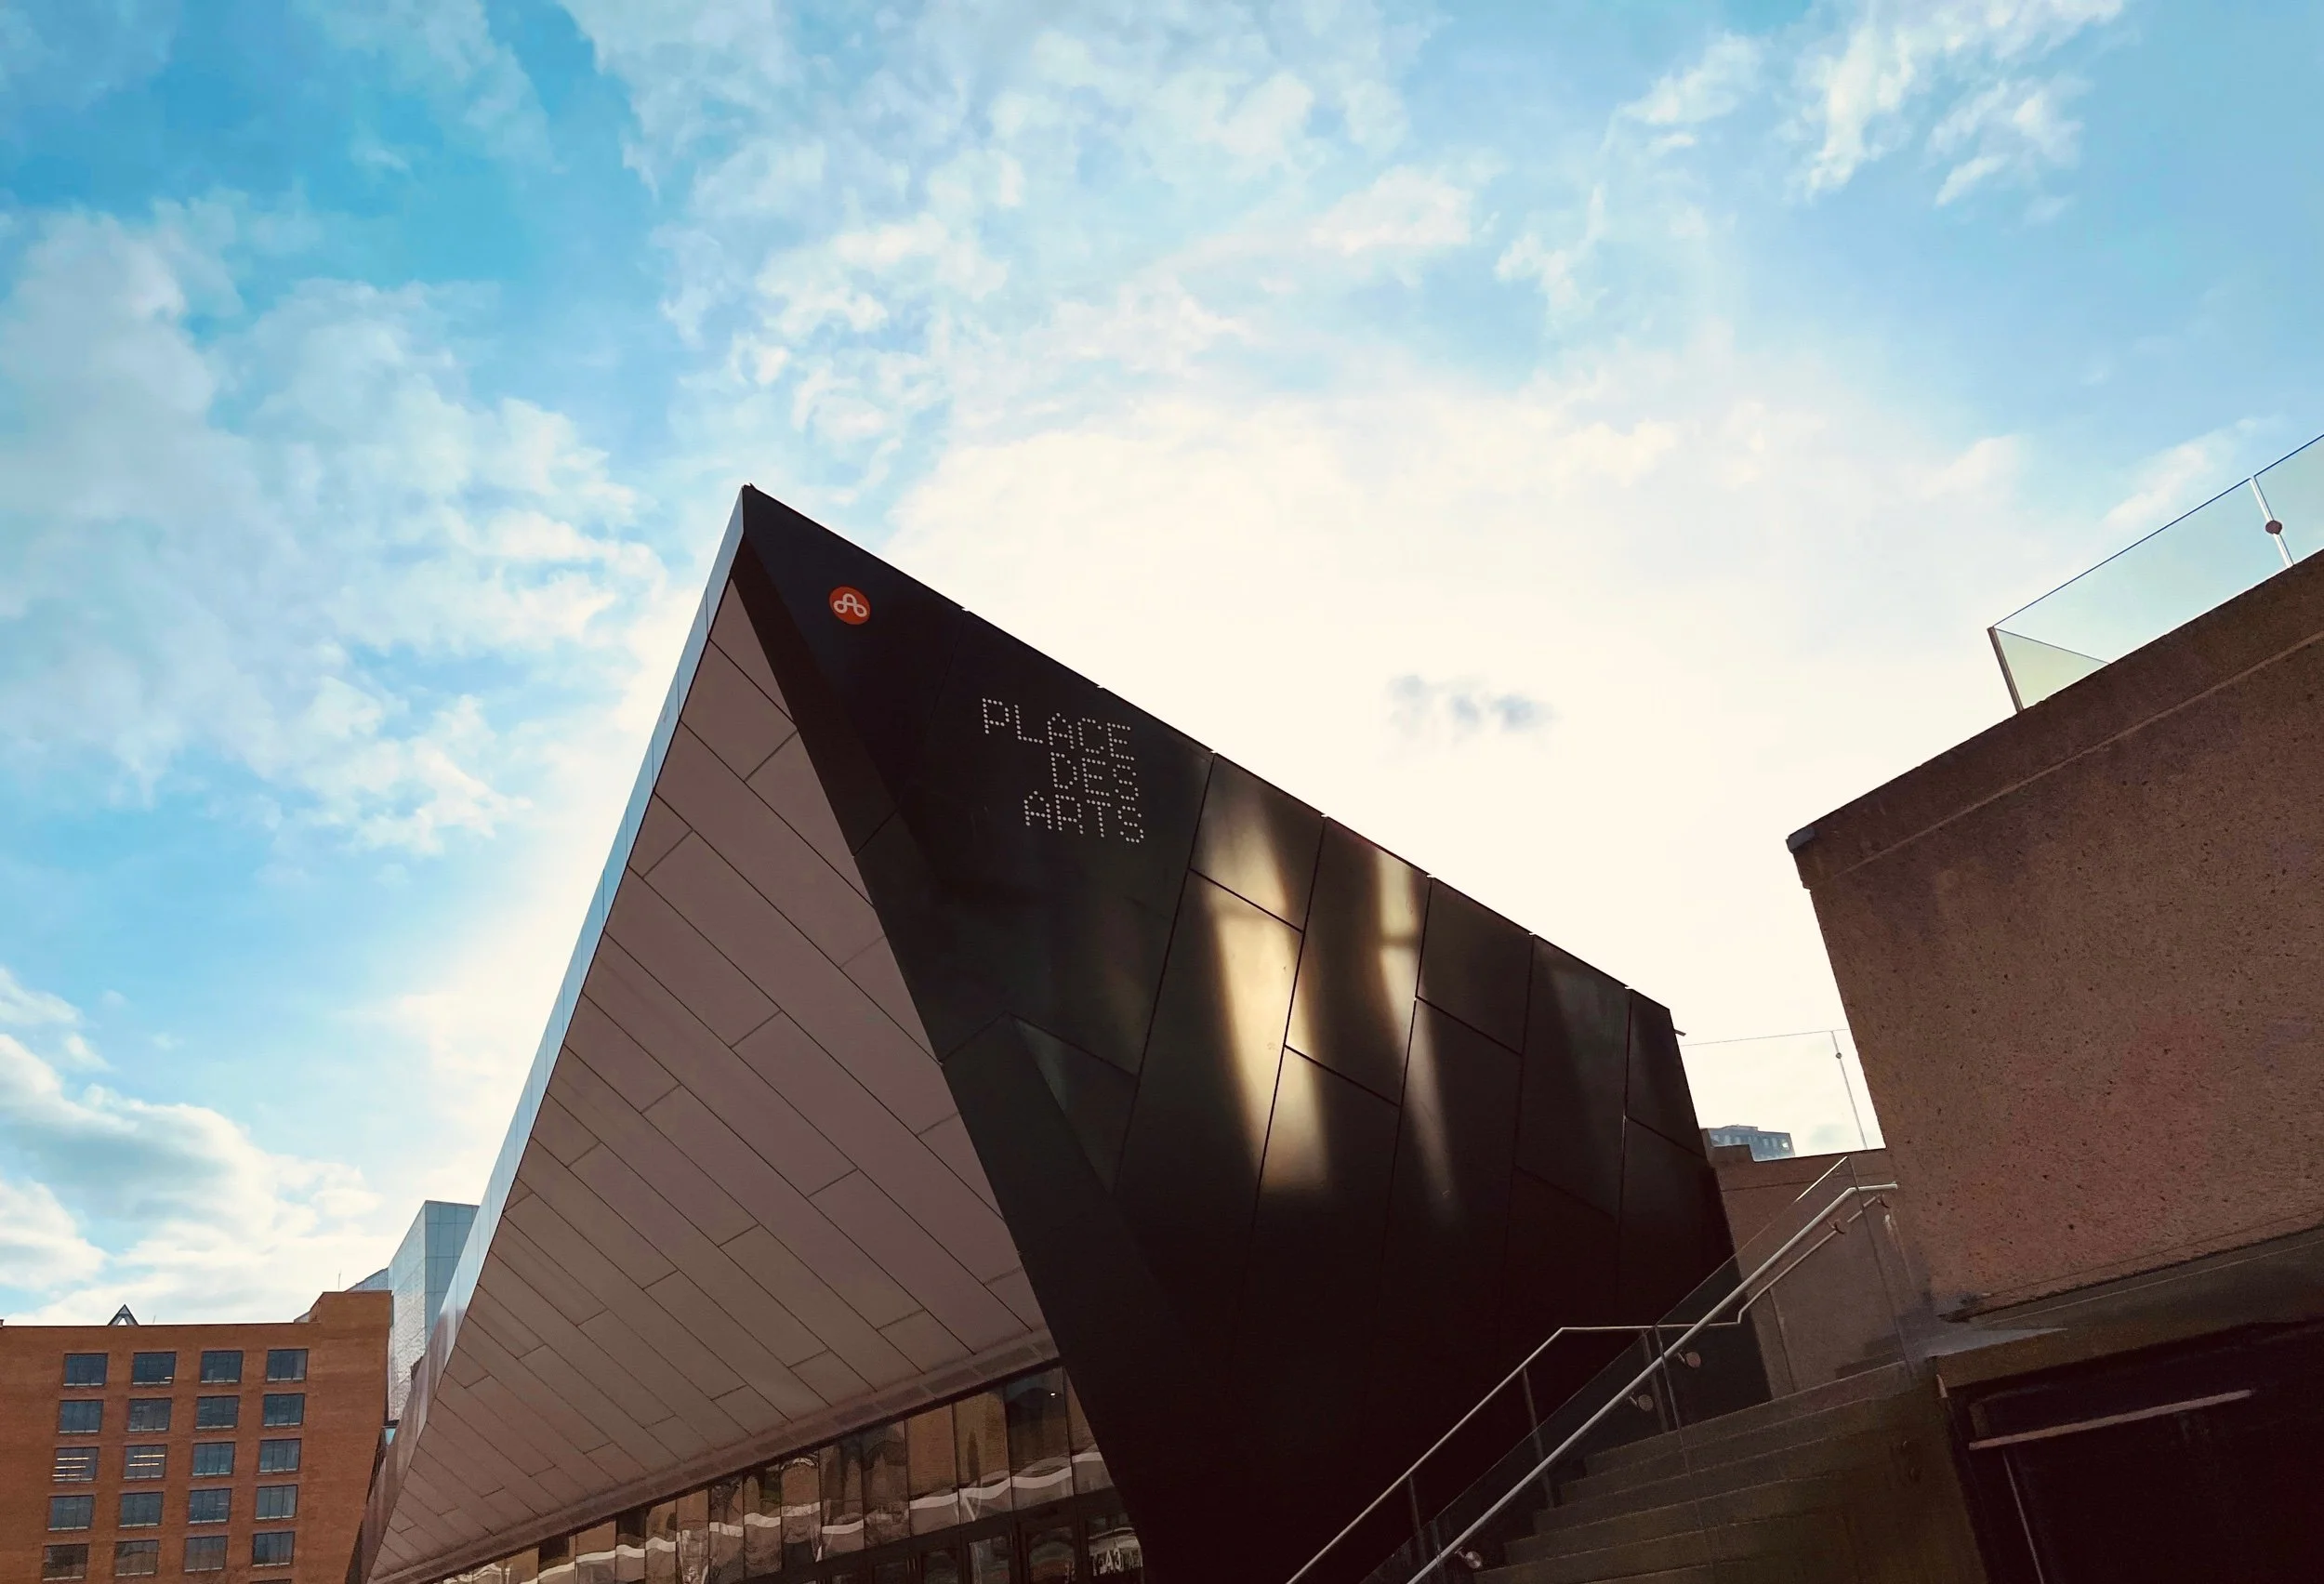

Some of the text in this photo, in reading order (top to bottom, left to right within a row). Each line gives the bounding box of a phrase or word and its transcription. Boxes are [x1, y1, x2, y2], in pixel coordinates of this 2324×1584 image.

[982, 697, 1135, 760] PLACE
[1050, 751, 1139, 801] DES
[1023, 790, 1144, 843] ARTS
